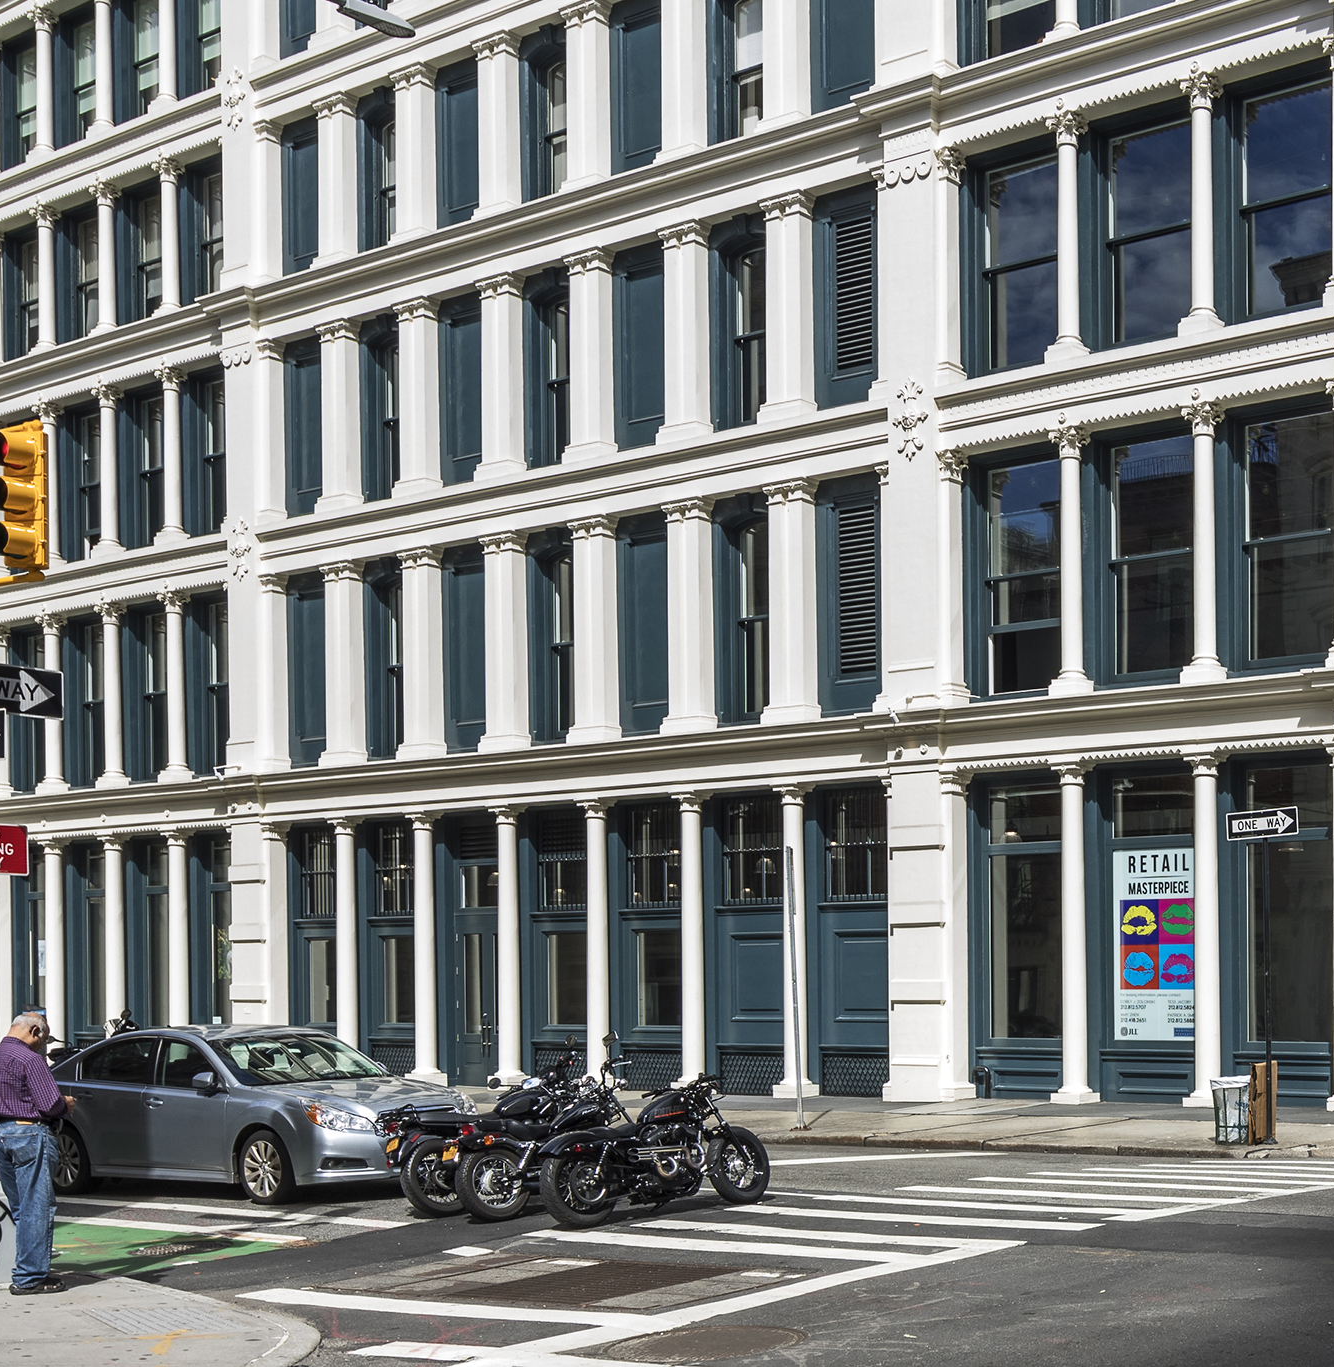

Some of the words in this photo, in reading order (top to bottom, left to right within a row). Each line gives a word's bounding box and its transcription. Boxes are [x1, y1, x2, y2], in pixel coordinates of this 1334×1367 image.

[1237, 819, 1258, 831] ONE
[1266, 817, 1287, 828] WAY
[1128, 853, 1189, 873] RETAIL
[1128, 881, 1189, 895] MASTERPIECE
